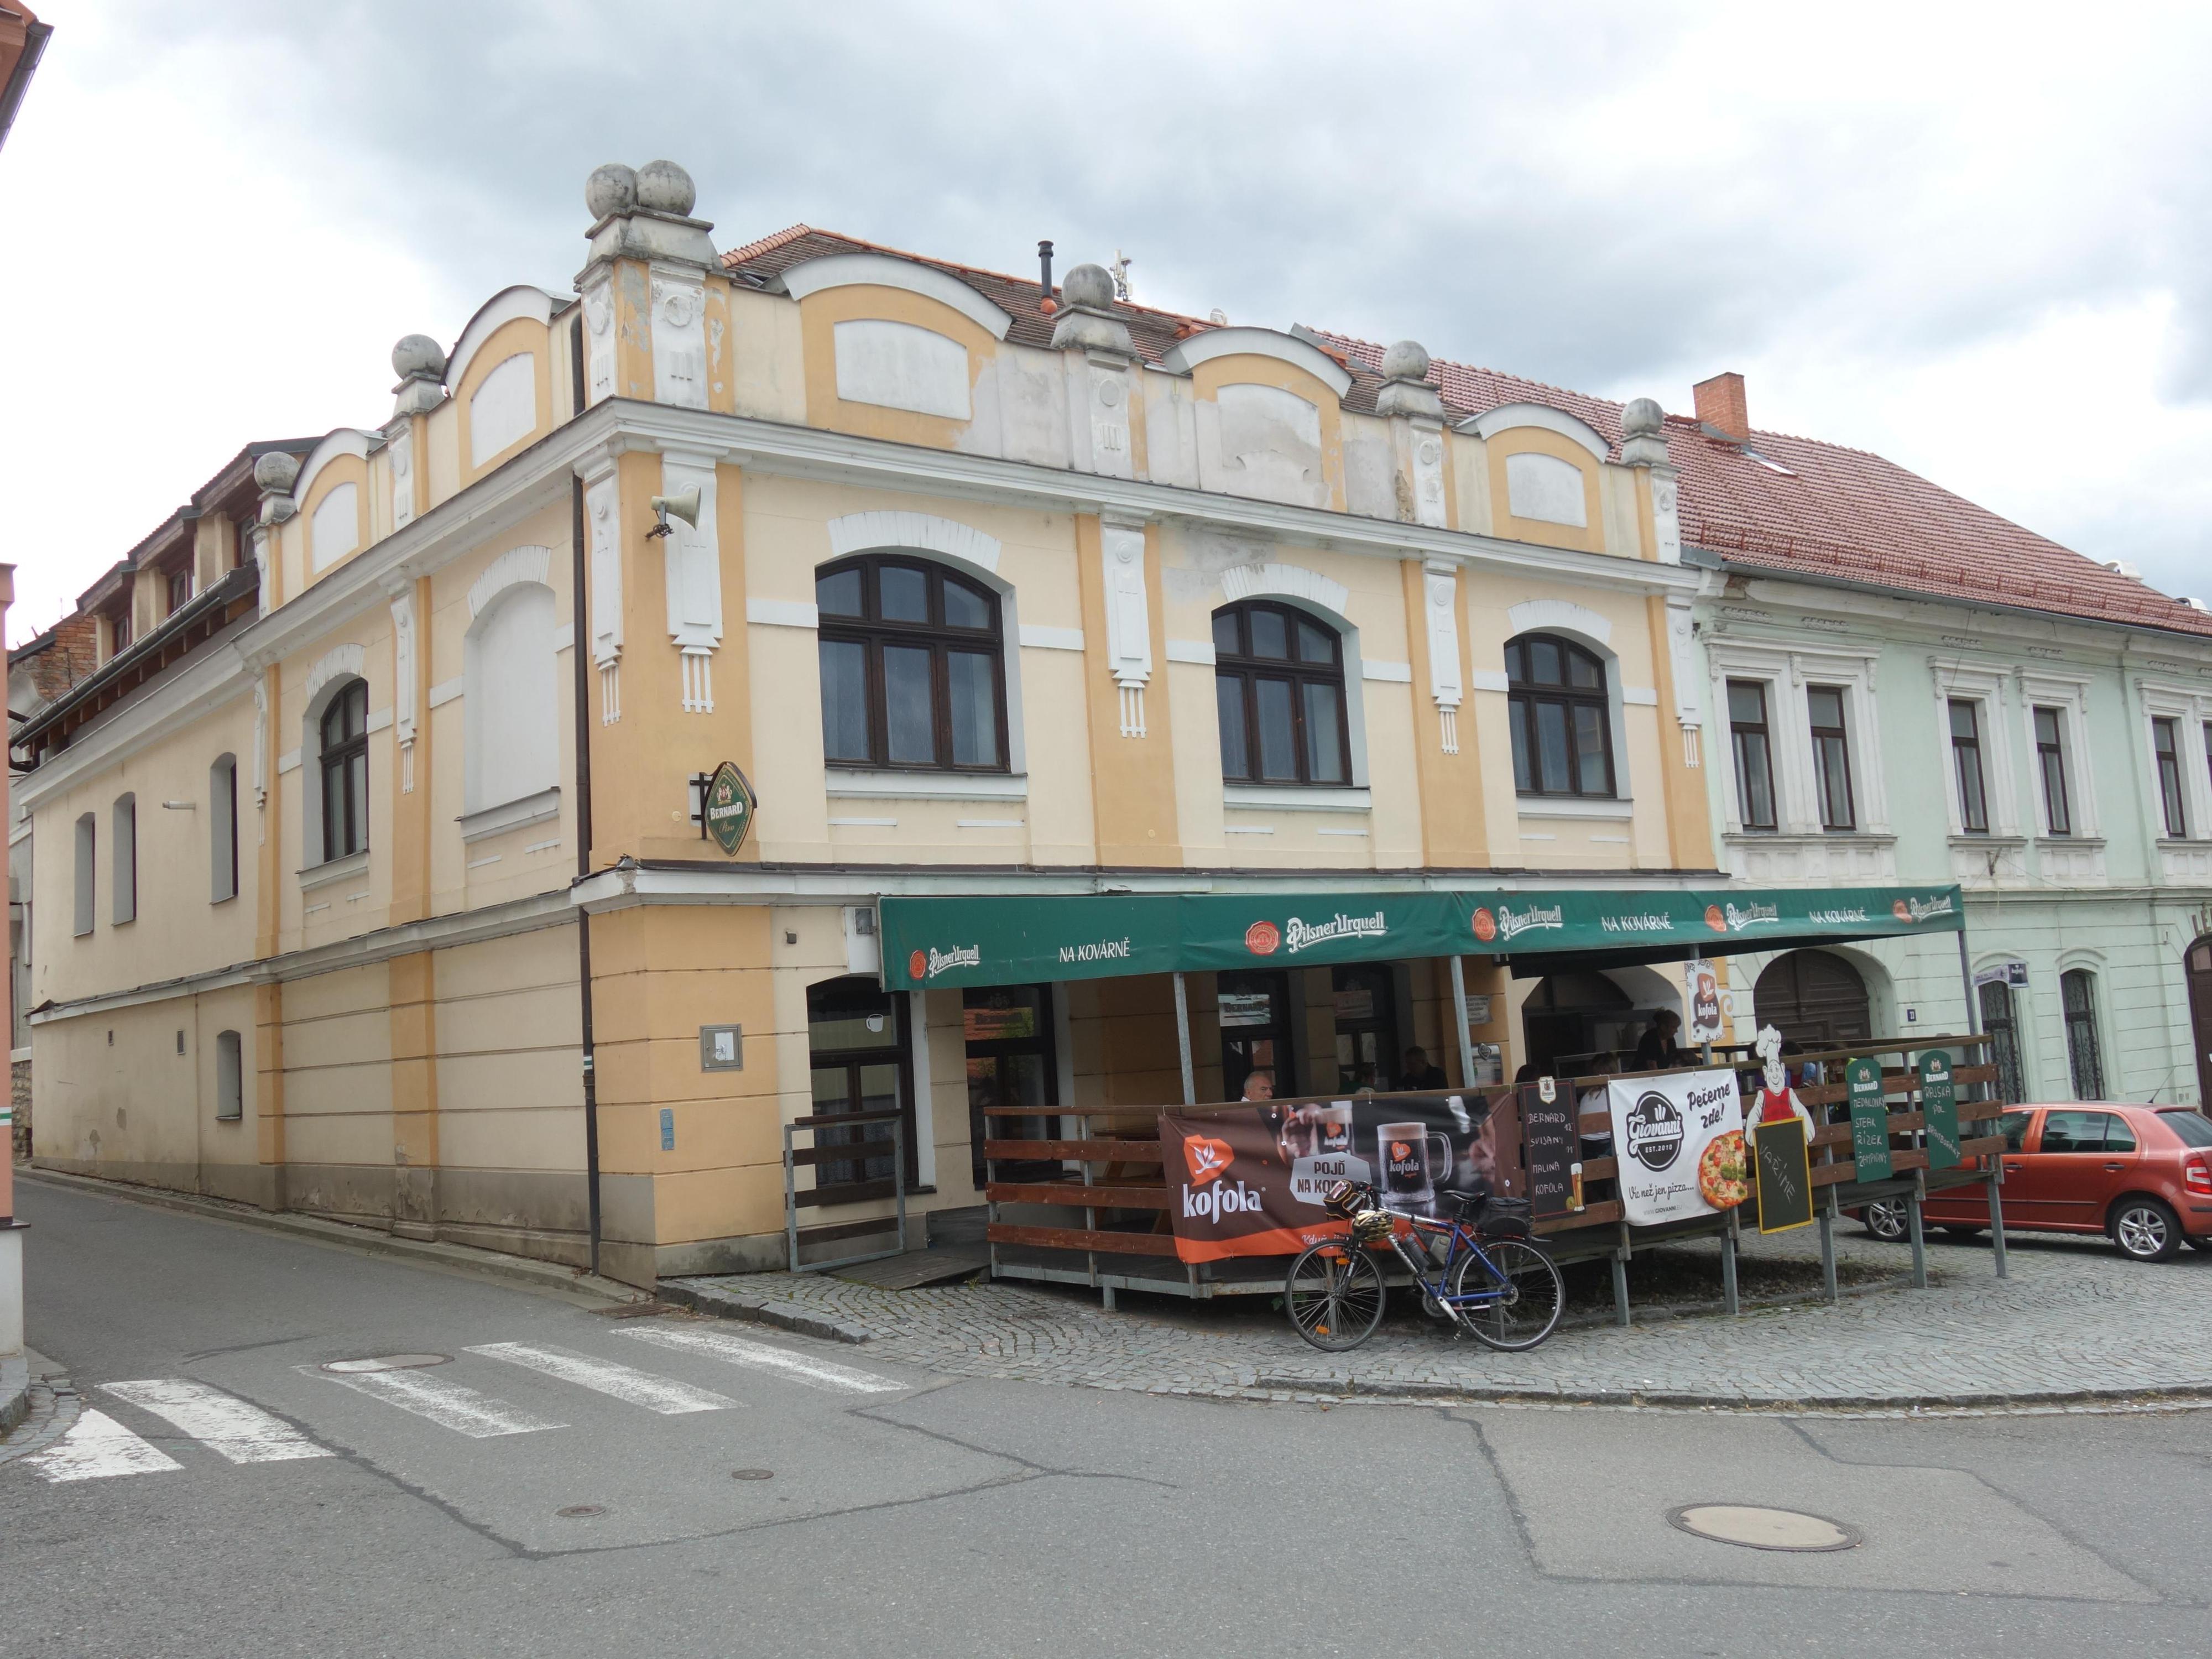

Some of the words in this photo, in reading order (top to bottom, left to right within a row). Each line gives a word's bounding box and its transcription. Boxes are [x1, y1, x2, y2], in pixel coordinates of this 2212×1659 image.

[709, 801, 743, 821] BERNARD
[1499, 905, 1532, 941] Pilsner
[1529, 904, 1562, 930] Urquell
[1601, 916, 1621, 931] NA
[1621, 911, 1674, 931] KOVÁRNĚ
[1809, 911, 1827, 923] NA
[1286, 917, 1337, 954] Pilsner
[1334, 911, 1385, 938] Urquell
[1060, 946, 1074, 963] NA
[1078, 936, 1130, 961] KOVÁRNĚ
[928, 947, 954, 978] Pilsner
[953, 944, 979, 968] Urquell
[1698, 1003, 1717, 1019] kofola
[1926, 1071, 1949, 1083] BERNARD
[1854, 1081, 1878, 1093] BERNARD
[1687, 1083, 1730, 1112] Pečeme
[1528, 1112, 1566, 1124] BERNARD
[1701, 1103, 1725, 1129] zde!
[1627, 1114, 1682, 1155] Giovanni
[1645, 1144, 1672, 1153] EST.2010
[1314, 1160, 1345, 1175] POJĎ
[1389, 1159, 1419, 1175] kofola
[1532, 1161, 1560, 1174] MALINA
[1297, 1179, 1311, 1193] NA
[1535, 1182, 1563, 1196] KOFOLA
[1641, 1183, 1654, 1198] než
[1653, 1185, 1667, 1203] jen
[1183, 1180, 1263, 1224] kofola
